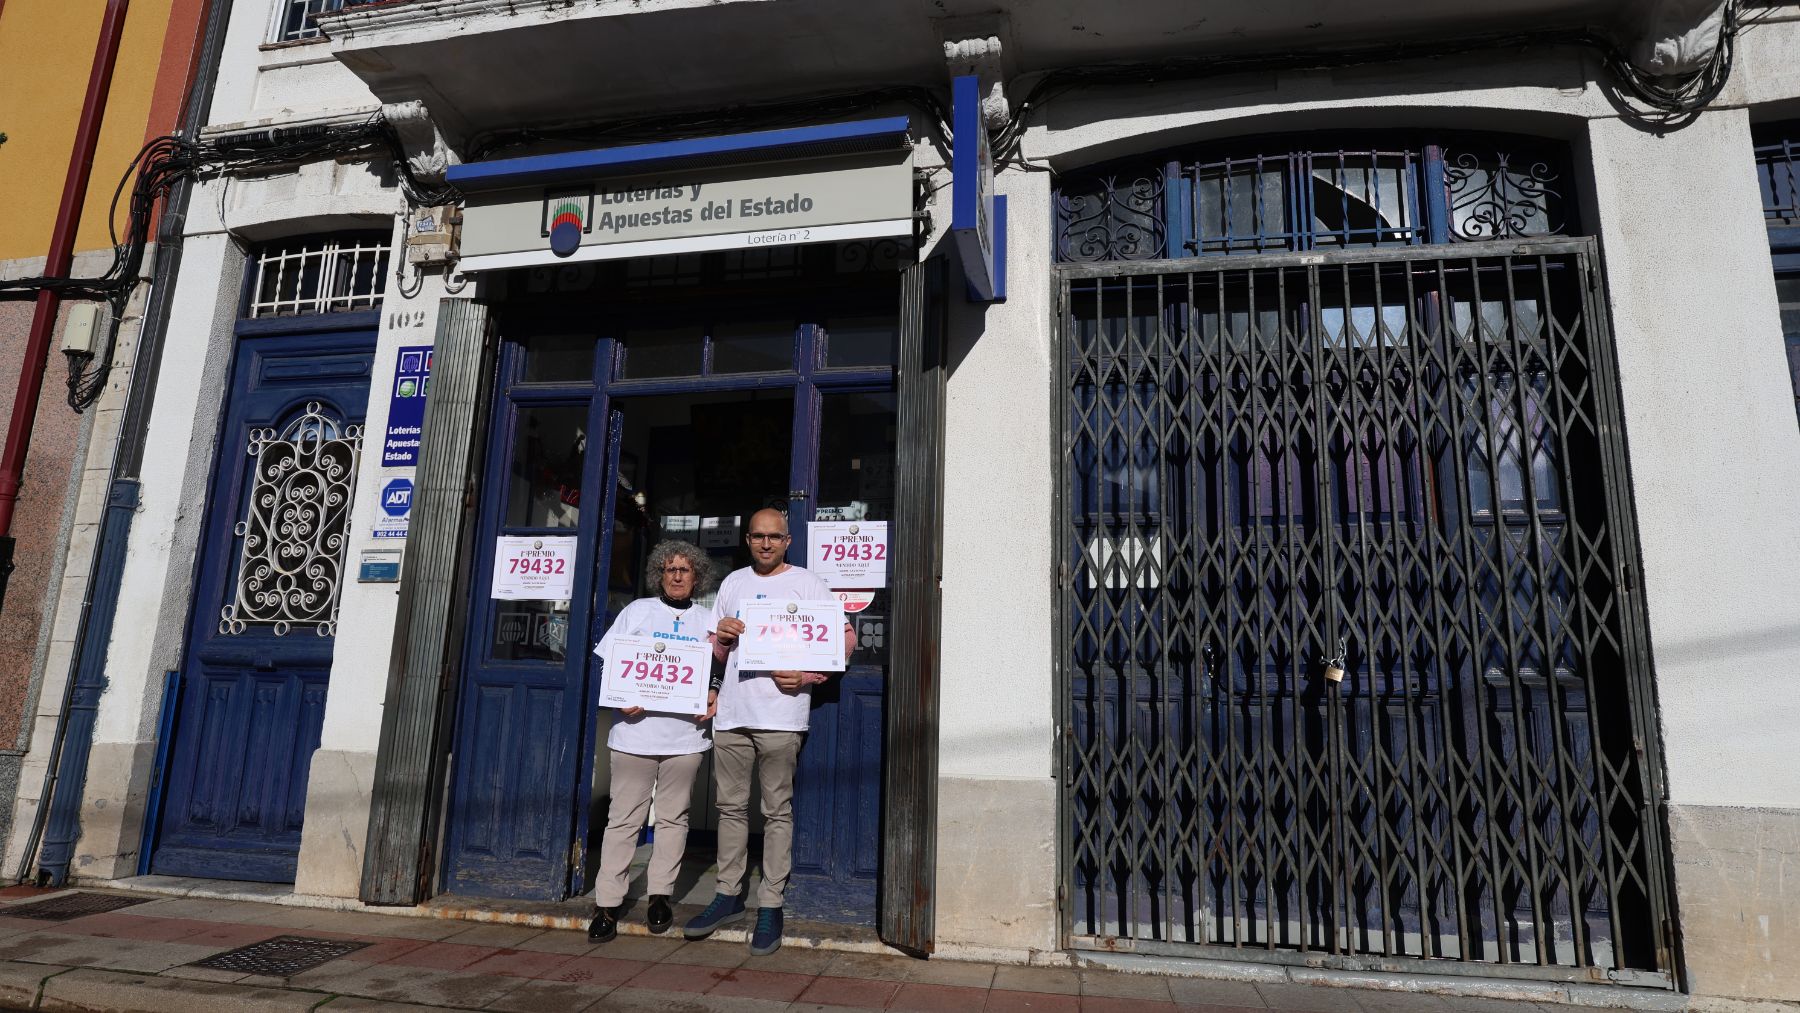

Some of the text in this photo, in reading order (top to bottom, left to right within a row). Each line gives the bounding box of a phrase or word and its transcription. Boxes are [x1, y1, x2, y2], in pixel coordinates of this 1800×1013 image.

[689, 183, 702, 202] y
[598, 193, 814, 234] Apuestas del Estado
[747, 233, 787, 245] Lotería
[804, 230, 811, 240] 2
[388, 310, 425, 330] 102
[388, 426, 421, 435] Loterías
[384, 452, 412, 461] Estado
[387, 491, 410, 504] ADT
[821, 543, 886, 561] 79432
[510, 558, 565, 574] 79432
[644, 652, 681, 664] PREMIO
[620, 660, 694, 685] 79432
